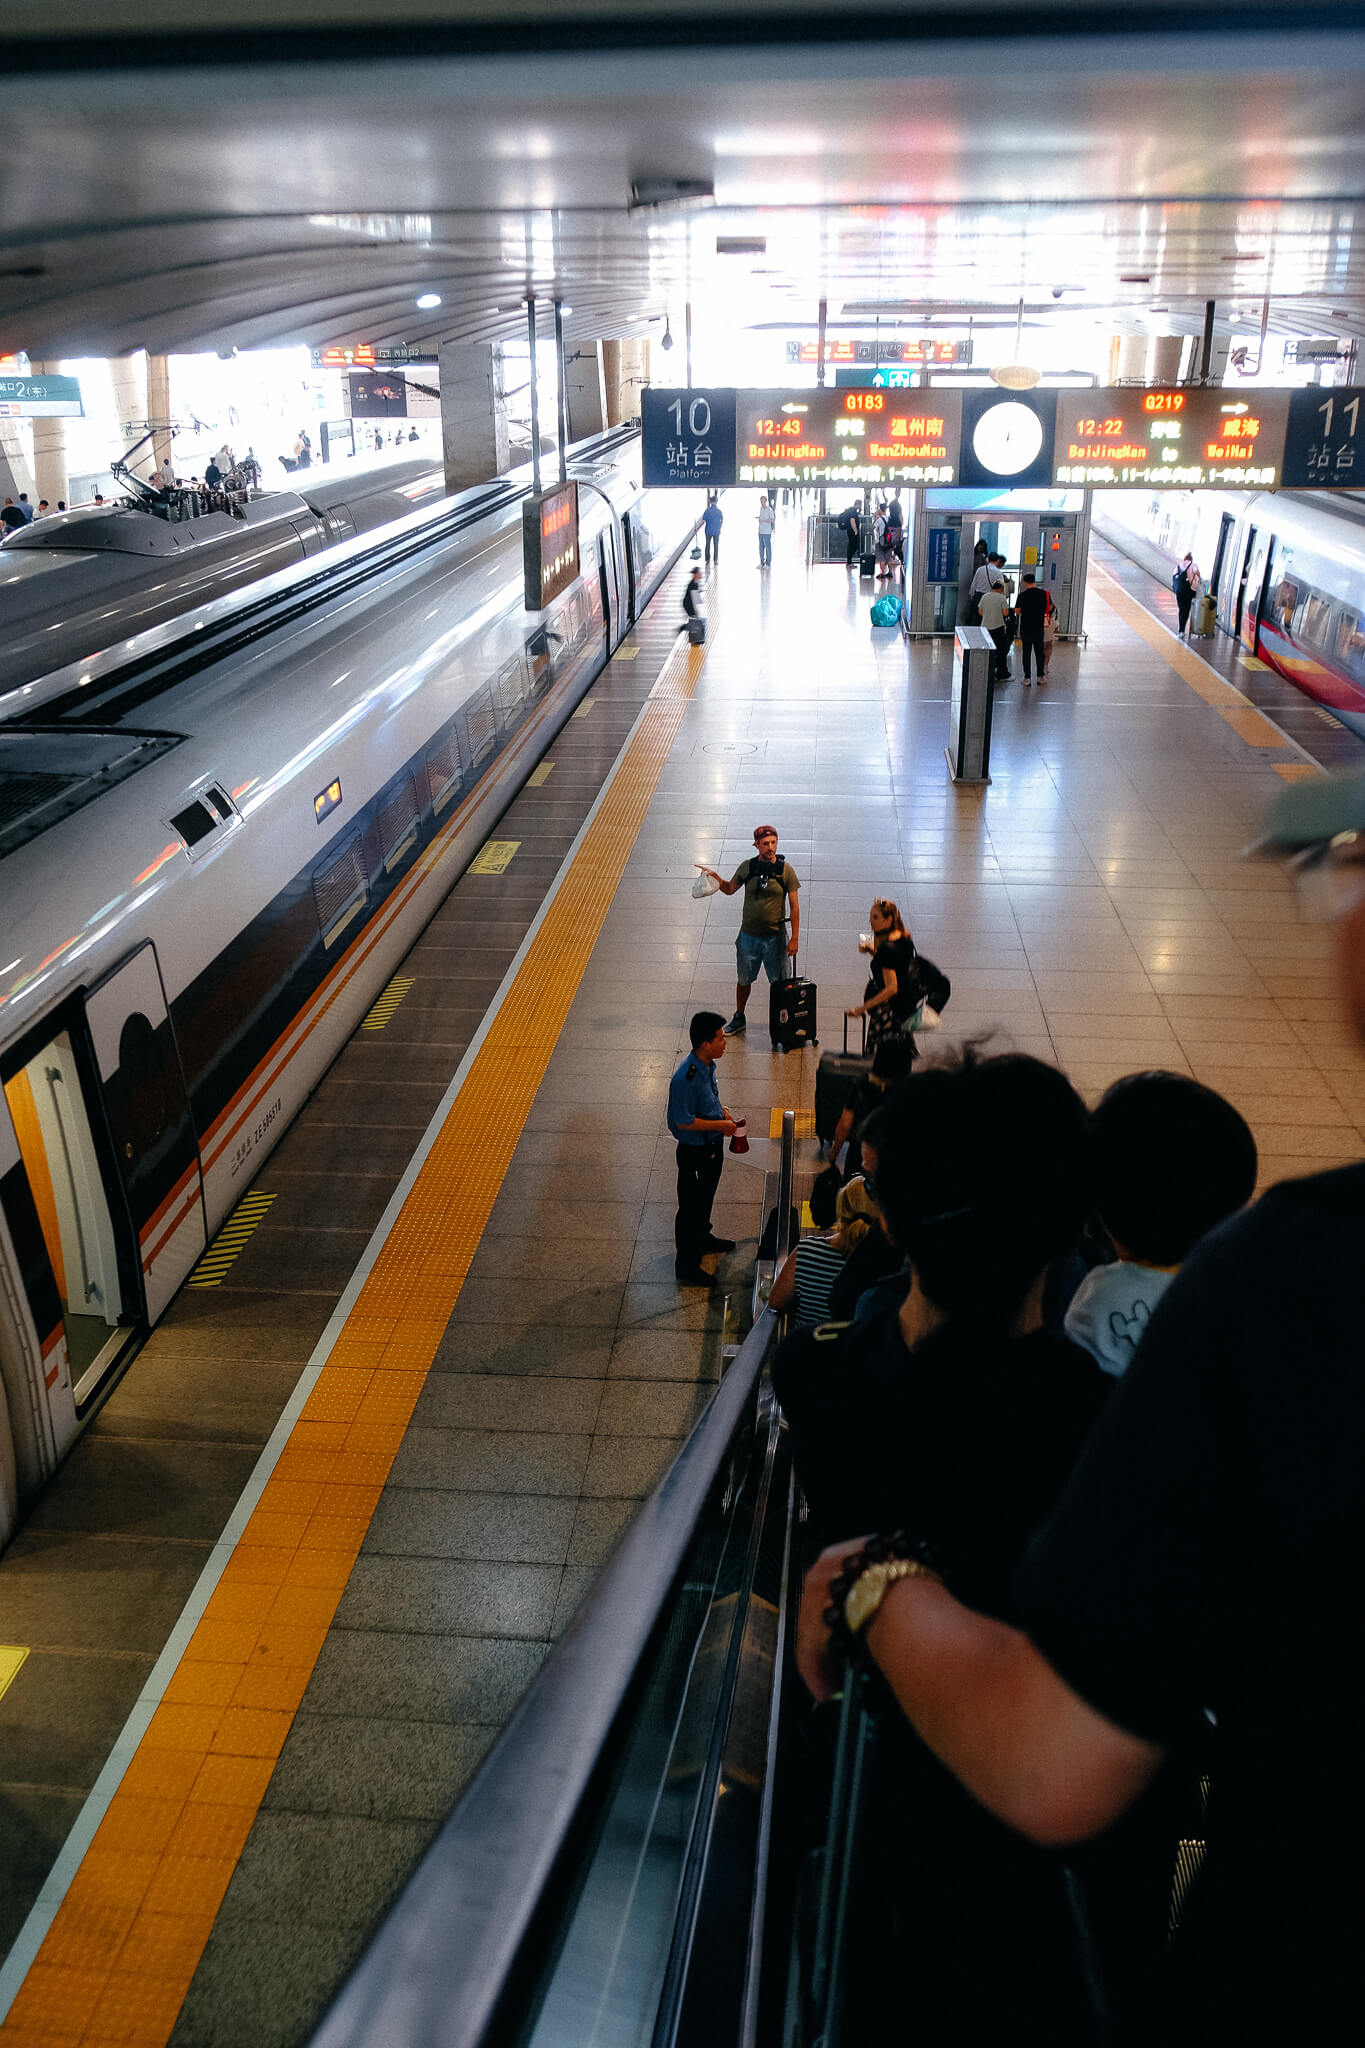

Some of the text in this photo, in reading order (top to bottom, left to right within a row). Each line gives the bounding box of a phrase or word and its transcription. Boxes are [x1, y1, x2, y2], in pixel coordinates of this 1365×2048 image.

[846, 395, 884, 410] G183
[1145, 395, 1184, 410] G219
[667, 397, 711, 436] 10
[1318, 397, 1360, 437] 11
[756, 420, 801, 435] 12:43
[891, 418, 944, 437] 温州南
[1077, 420, 1124, 435] 12:22
[1223, 418, 1260, 437] 威海
[666, 441, 713, 466] 站台
[749, 443, 946, 461] BeiJingNan to WenZhouNan
[1068, 444, 1254, 462] BeiJingNan to WeiHai
[1306, 443, 1355, 468] 站台
